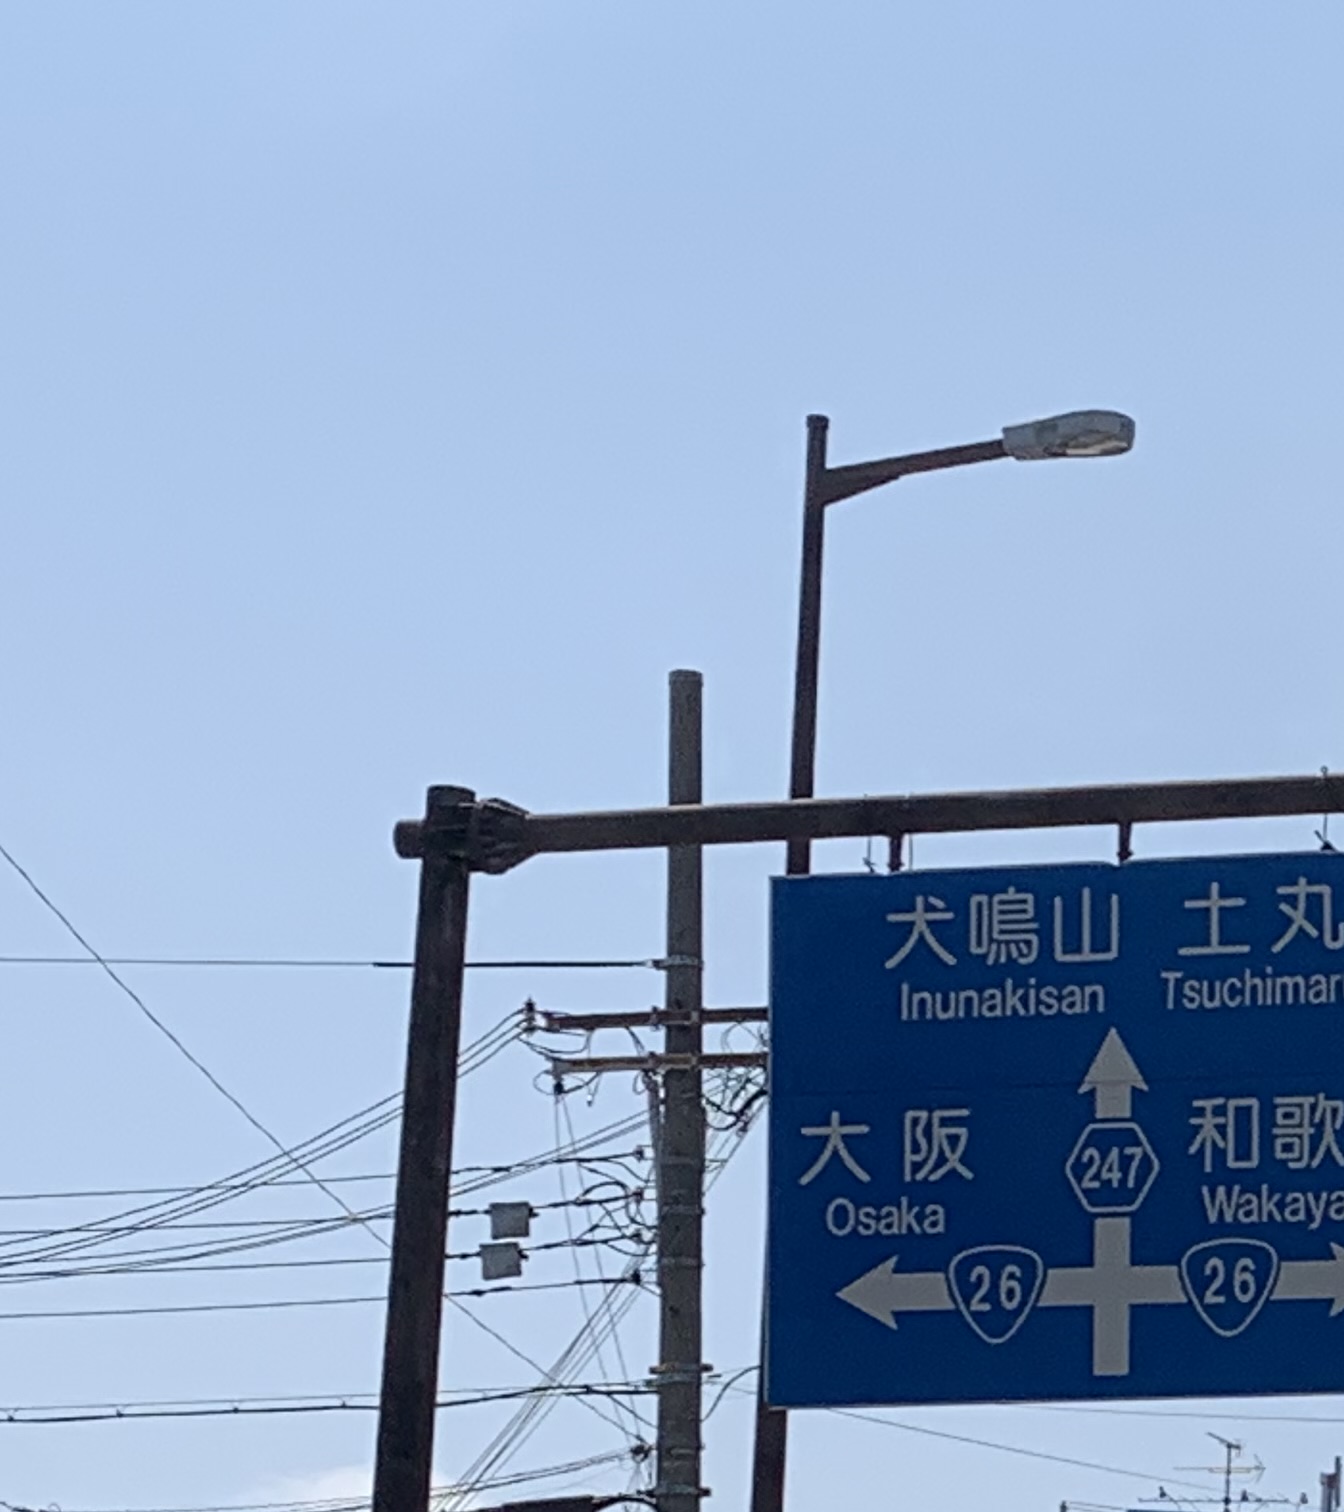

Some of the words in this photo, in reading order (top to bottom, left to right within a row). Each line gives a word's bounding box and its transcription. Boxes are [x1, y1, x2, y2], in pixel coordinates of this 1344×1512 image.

[884, 887, 1119, 969] 犬鳴山
[901, 978, 1105, 1021] Inunakisan
[799, 1108, 974, 1186] 大阪
[1080, 1147, 1143, 1190] 247
[825, 1197, 946, 1237] Osaka
[968, 1265, 1022, 1311] 26
[1202, 1257, 1256, 1303] 26
